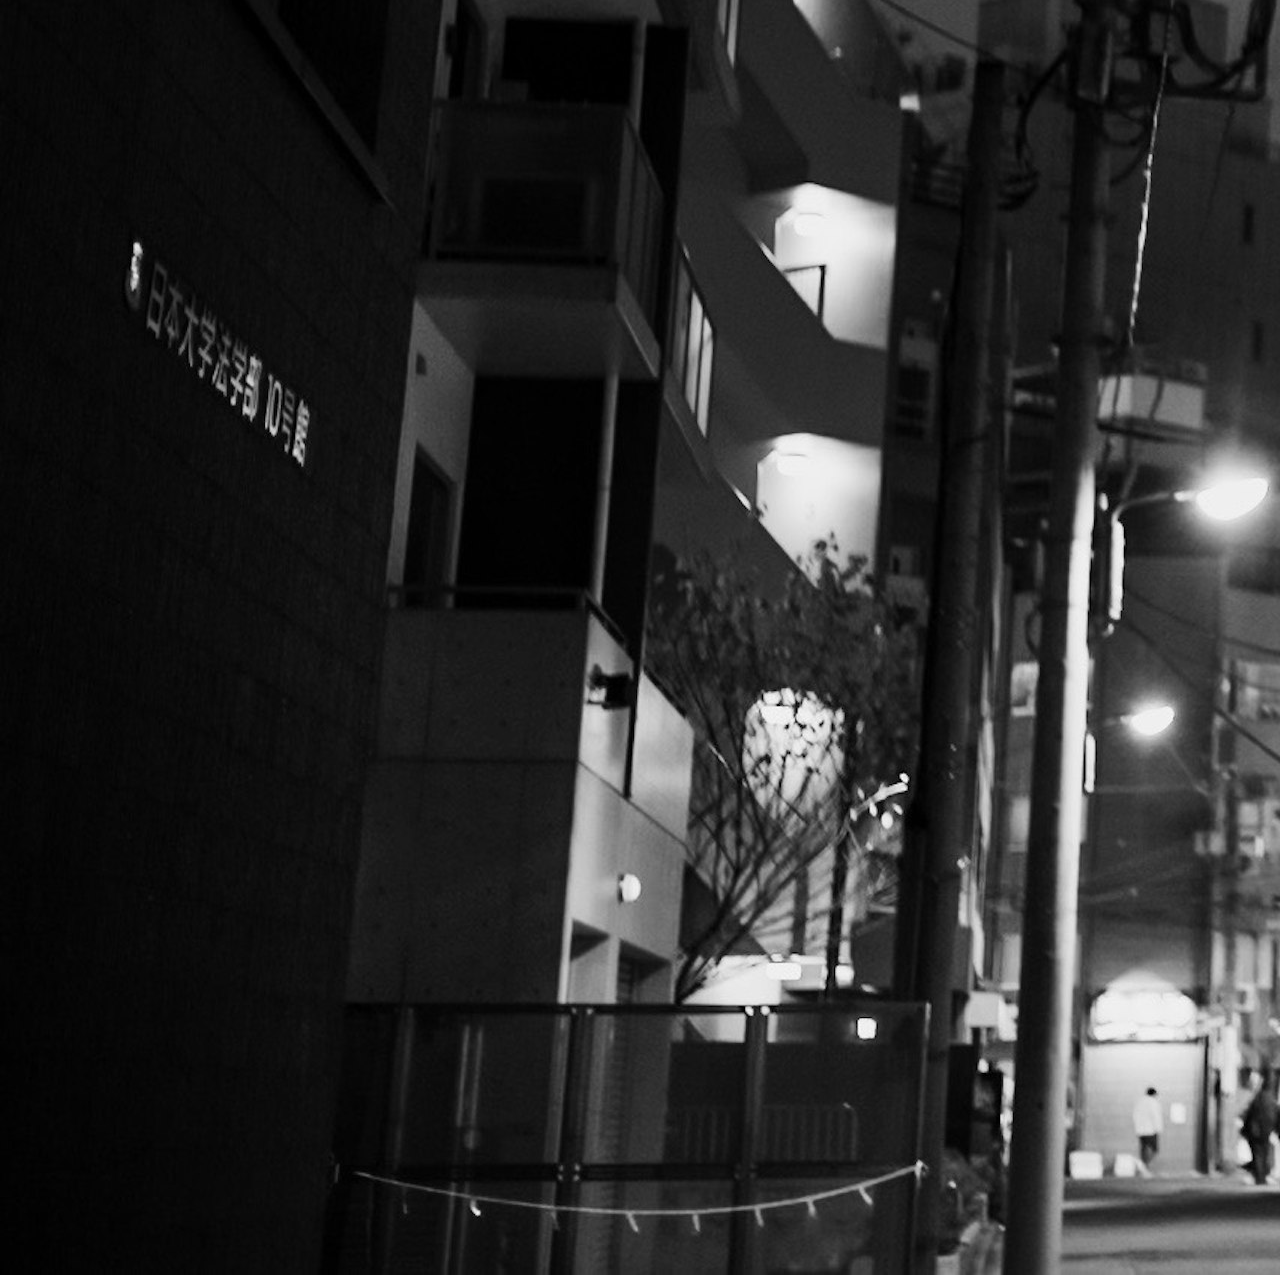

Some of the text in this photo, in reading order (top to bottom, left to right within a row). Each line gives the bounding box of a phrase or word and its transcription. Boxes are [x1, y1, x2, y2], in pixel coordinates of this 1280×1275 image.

[146, 261, 310, 467] 日本大学法学部 10号館
